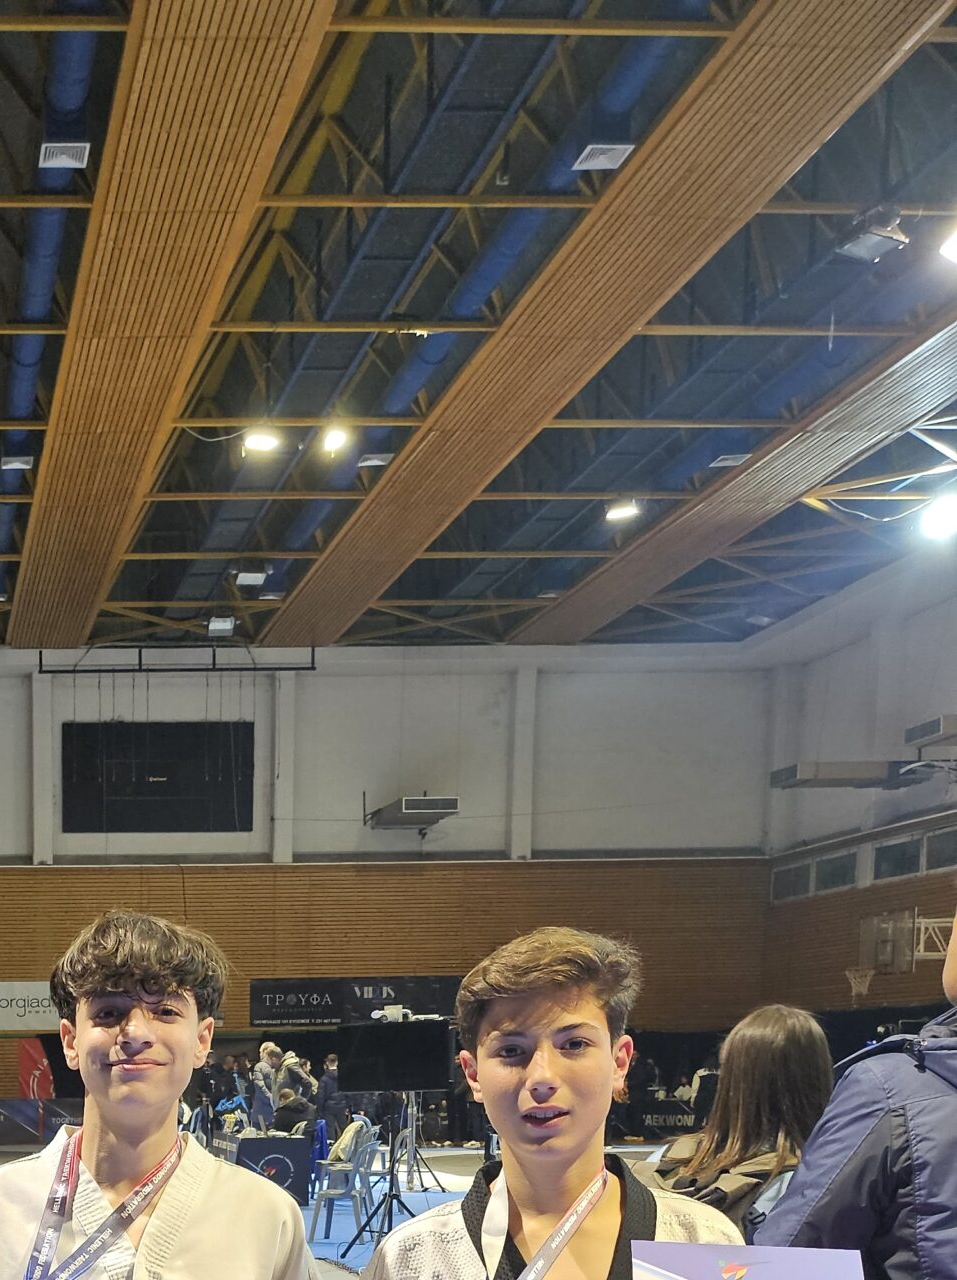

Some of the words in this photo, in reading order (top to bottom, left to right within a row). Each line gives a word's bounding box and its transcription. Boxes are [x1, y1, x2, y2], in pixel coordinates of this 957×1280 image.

[58, 1135, 78, 1181] TAEKWONDO
[119, 1181, 154, 1219] FEDERATION
[37, 1226, 55, 1266] FEDERATION
[86, 1225, 113, 1255] HELLENIC
